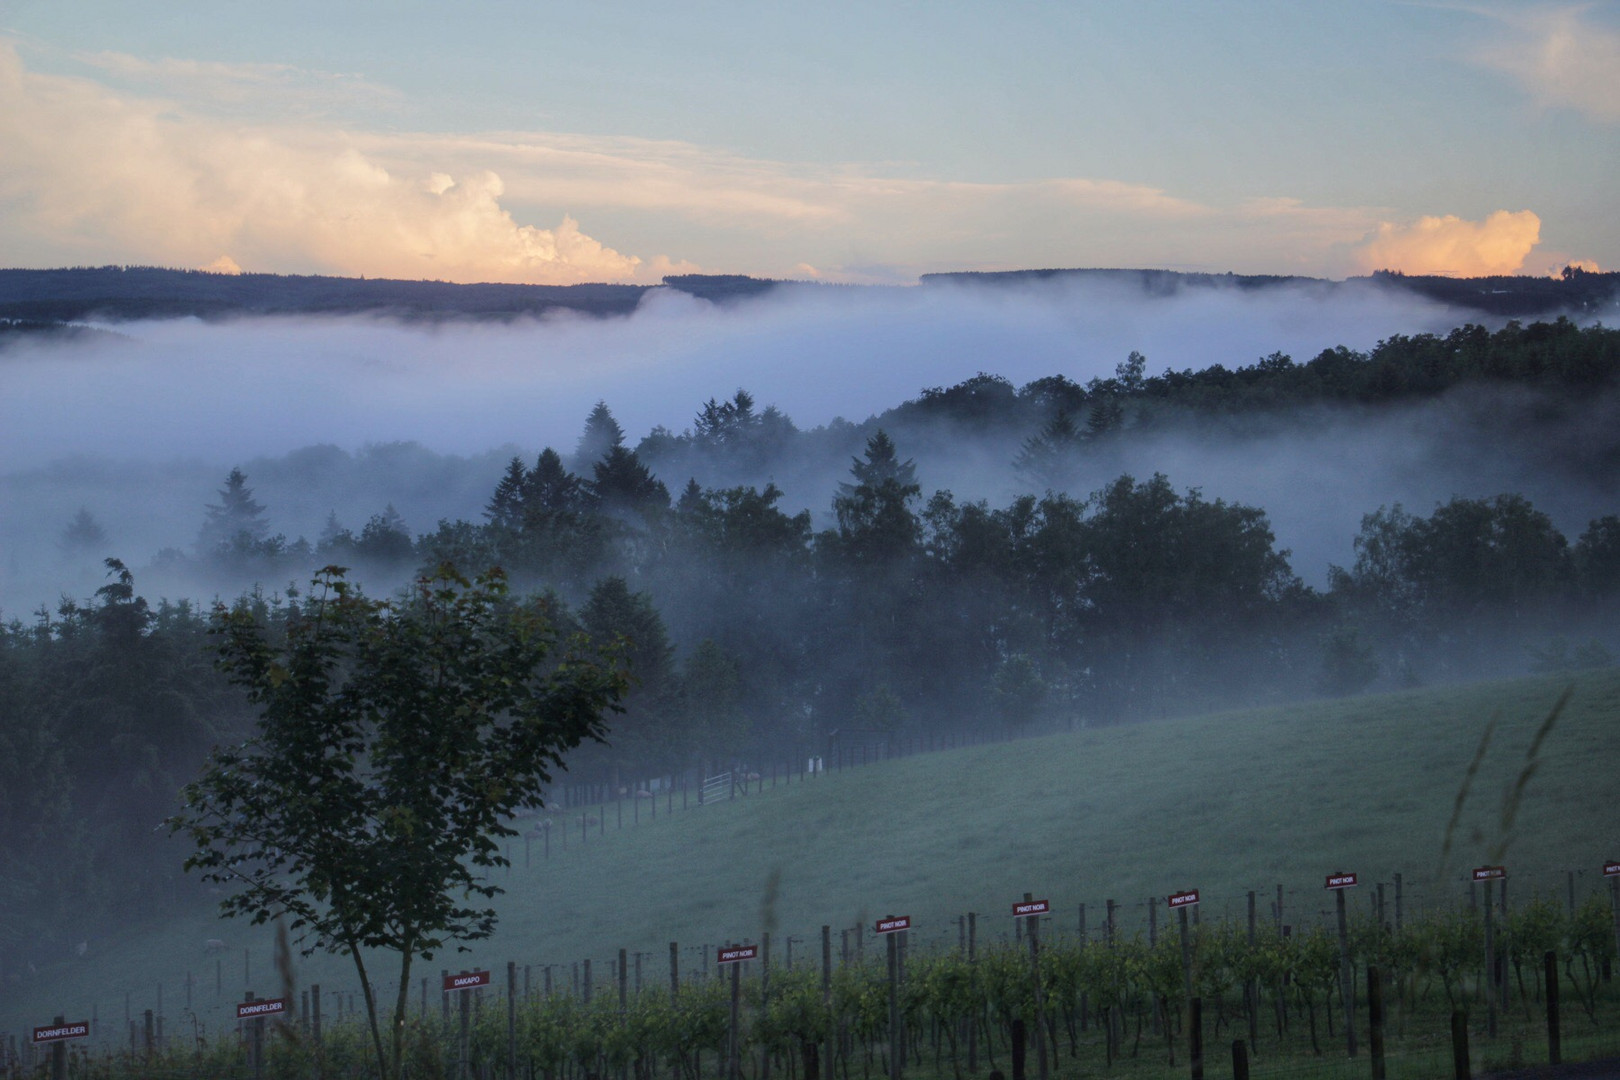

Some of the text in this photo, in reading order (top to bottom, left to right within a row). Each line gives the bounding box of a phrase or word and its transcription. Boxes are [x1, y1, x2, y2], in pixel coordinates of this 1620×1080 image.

[1171, 894, 1196, 904] PINOT NOIR
[1016, 905, 1031, 913] PINOT
[880, 921, 894, 929] PINOT
[722, 949, 753, 959] PINOT NOIR
[454, 976, 480, 986] DAKAPO
[240, 1002, 282, 1014] DORNFELDER
[37, 1026, 85, 1039] DORNFELDER
